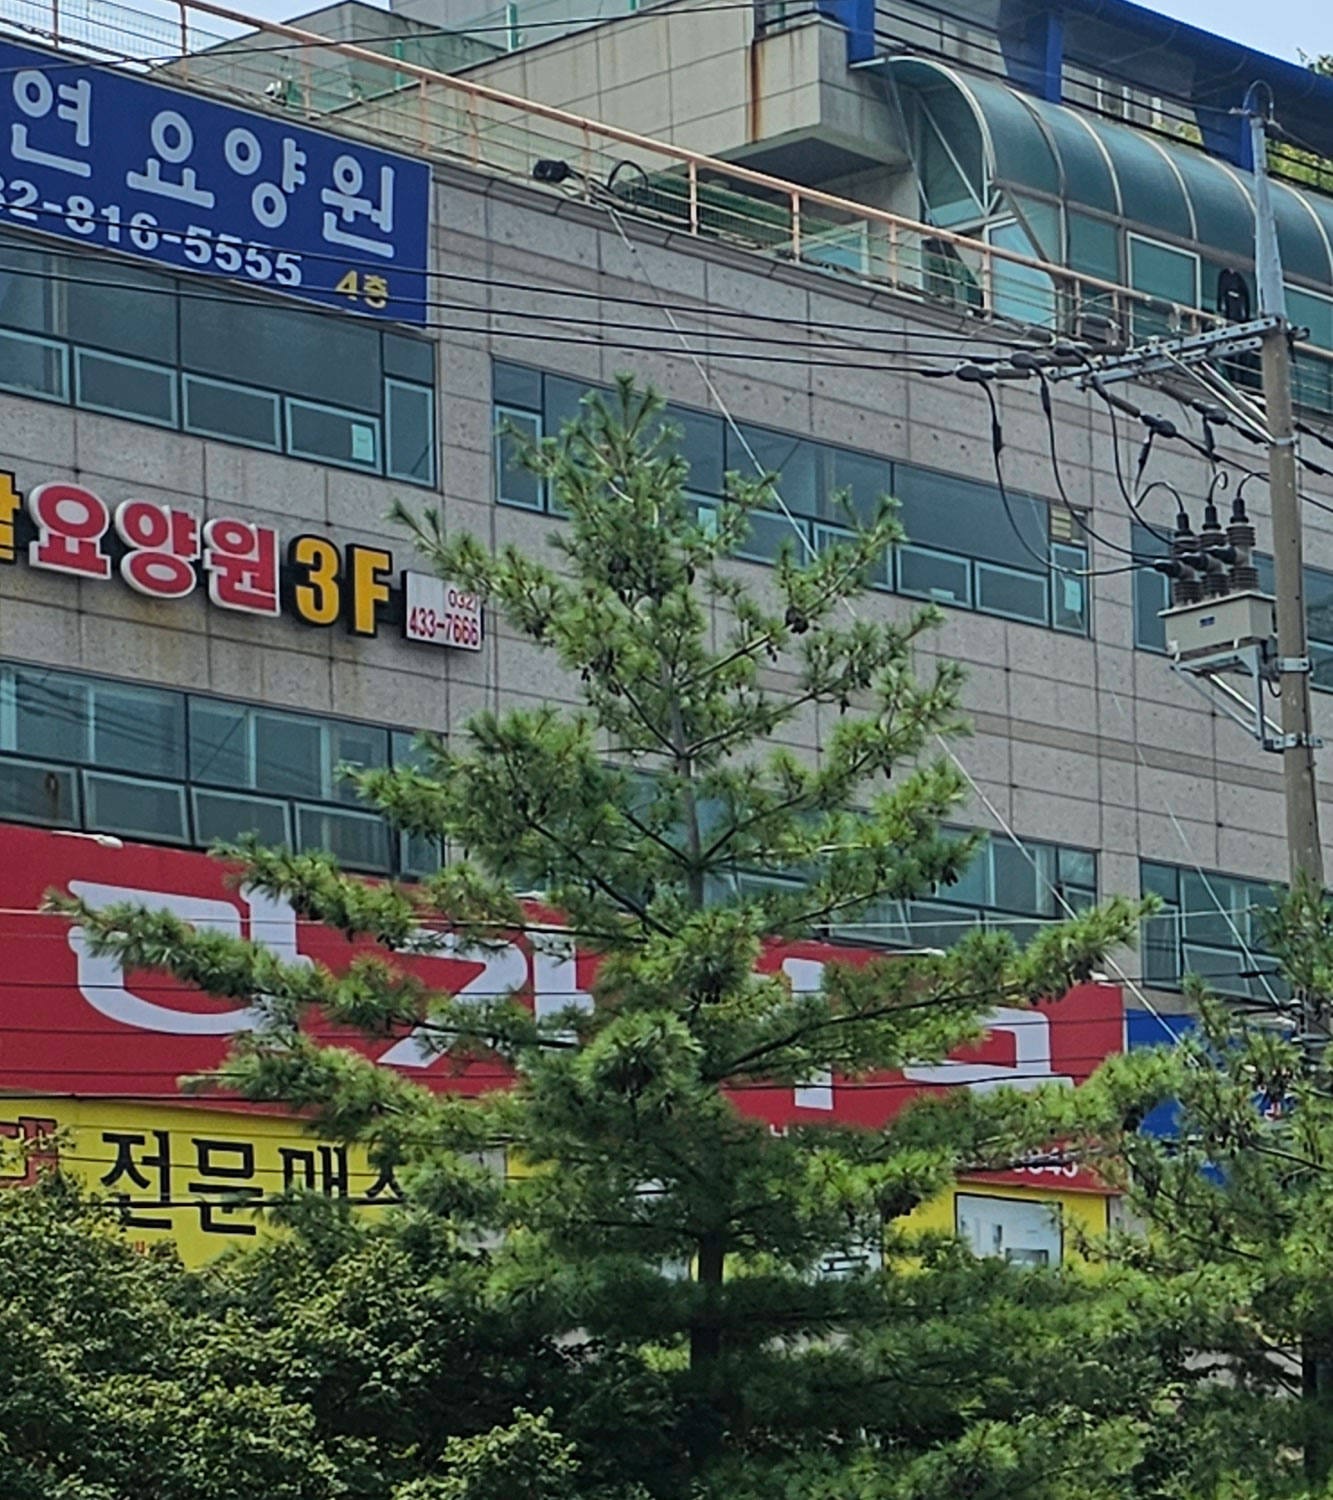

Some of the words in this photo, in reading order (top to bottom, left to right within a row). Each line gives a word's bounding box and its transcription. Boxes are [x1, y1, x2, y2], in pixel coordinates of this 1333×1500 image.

[0, 175, 303, 287] 2-816-5555
[335, 269, 390, 309] 4층
[126, 110, 395, 259] 요양원
[29, 481, 282, 617] 요양원
[290, 534, 393, 638] 3F
[409, 606, 480, 647] 433-7666
